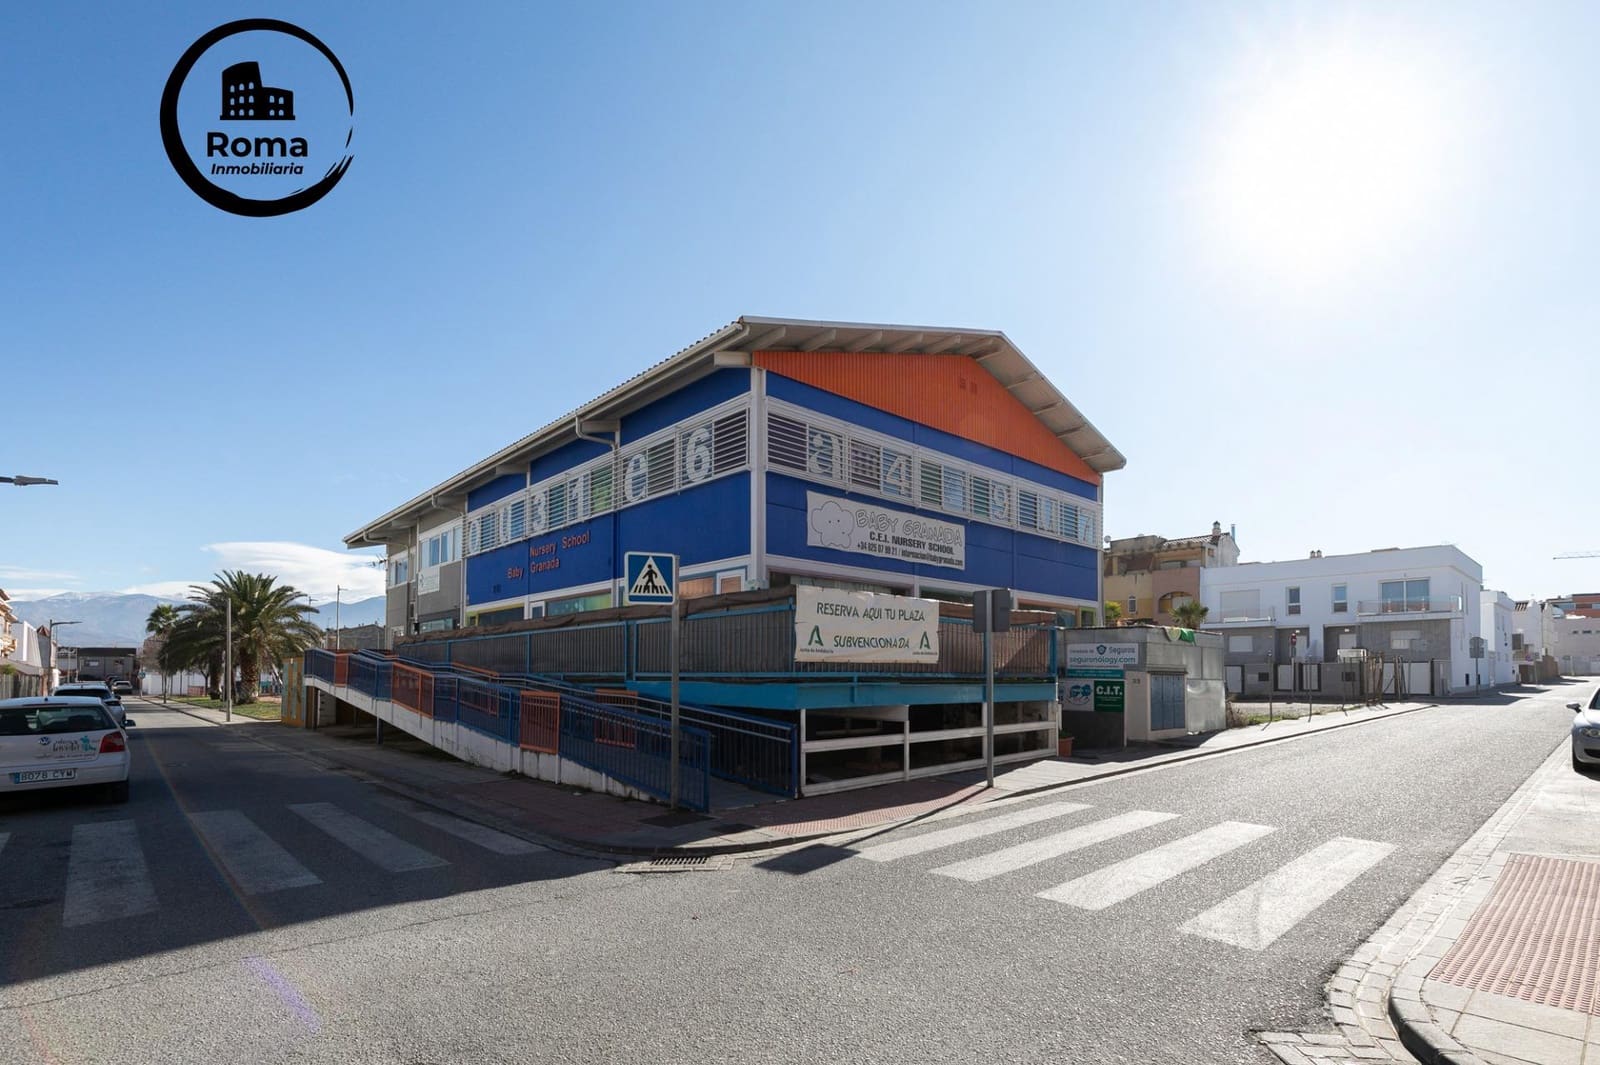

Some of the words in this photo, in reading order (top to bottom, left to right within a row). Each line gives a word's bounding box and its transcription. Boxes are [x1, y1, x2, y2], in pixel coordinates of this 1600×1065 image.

[686, 427, 712, 482] 6
[855, 509, 898, 533] BABY
[902, 519, 963, 547] GRANADA
[530, 541, 558, 558] Nursery
[561, 530, 590, 550] School
[869, 531, 890, 544] C.E.I.
[891, 535, 926, 550] NURSERY
[928, 542, 954, 556] SCHOOL
[507, 565, 524, 580] Baby
[530, 557, 560, 574] Granada
[816, 602, 859, 618] RESERVA
[862, 607, 882, 621] AQUI
[884, 608, 896, 621] TU
[898, 609, 925, 622] PLAZA
[833, 635, 910, 649] SUBVENCIONADA
[1096, 685, 1123, 695] C.I.T.
